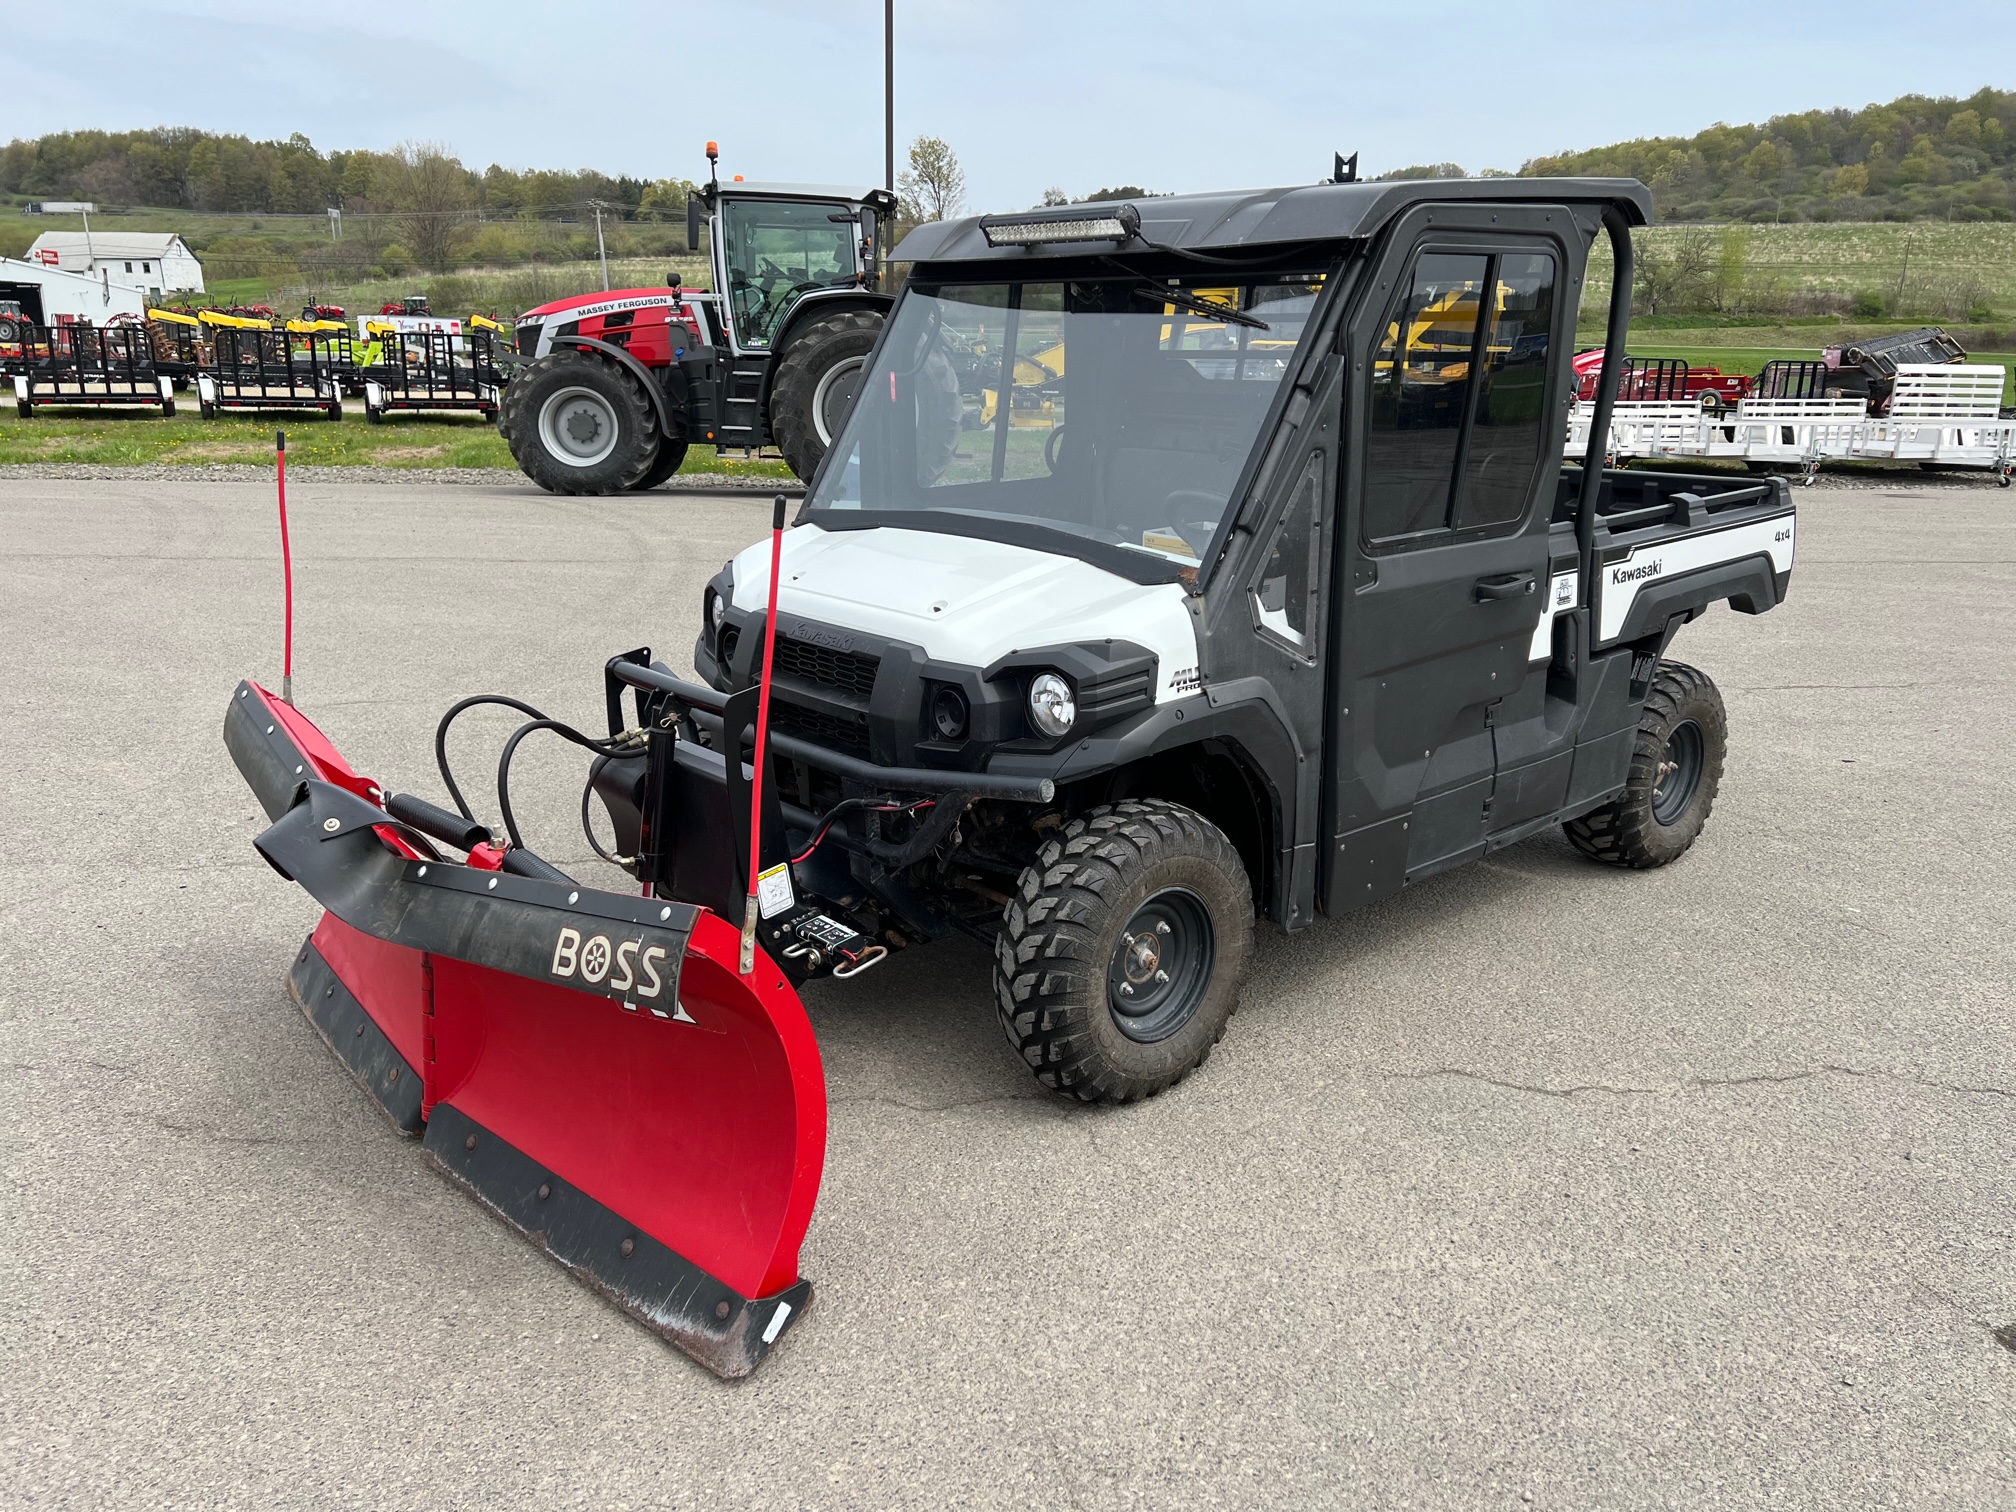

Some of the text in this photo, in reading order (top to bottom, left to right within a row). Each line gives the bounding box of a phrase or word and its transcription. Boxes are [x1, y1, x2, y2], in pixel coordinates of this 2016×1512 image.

[577, 297, 667, 317] MASSEY FERGUSON
[1774, 528, 1790, 542] 4x4
[1612, 559, 1662, 585] Kawasaki
[789, 621, 856, 651] Kawasaki
[551, 927, 666, 998] BOSS
